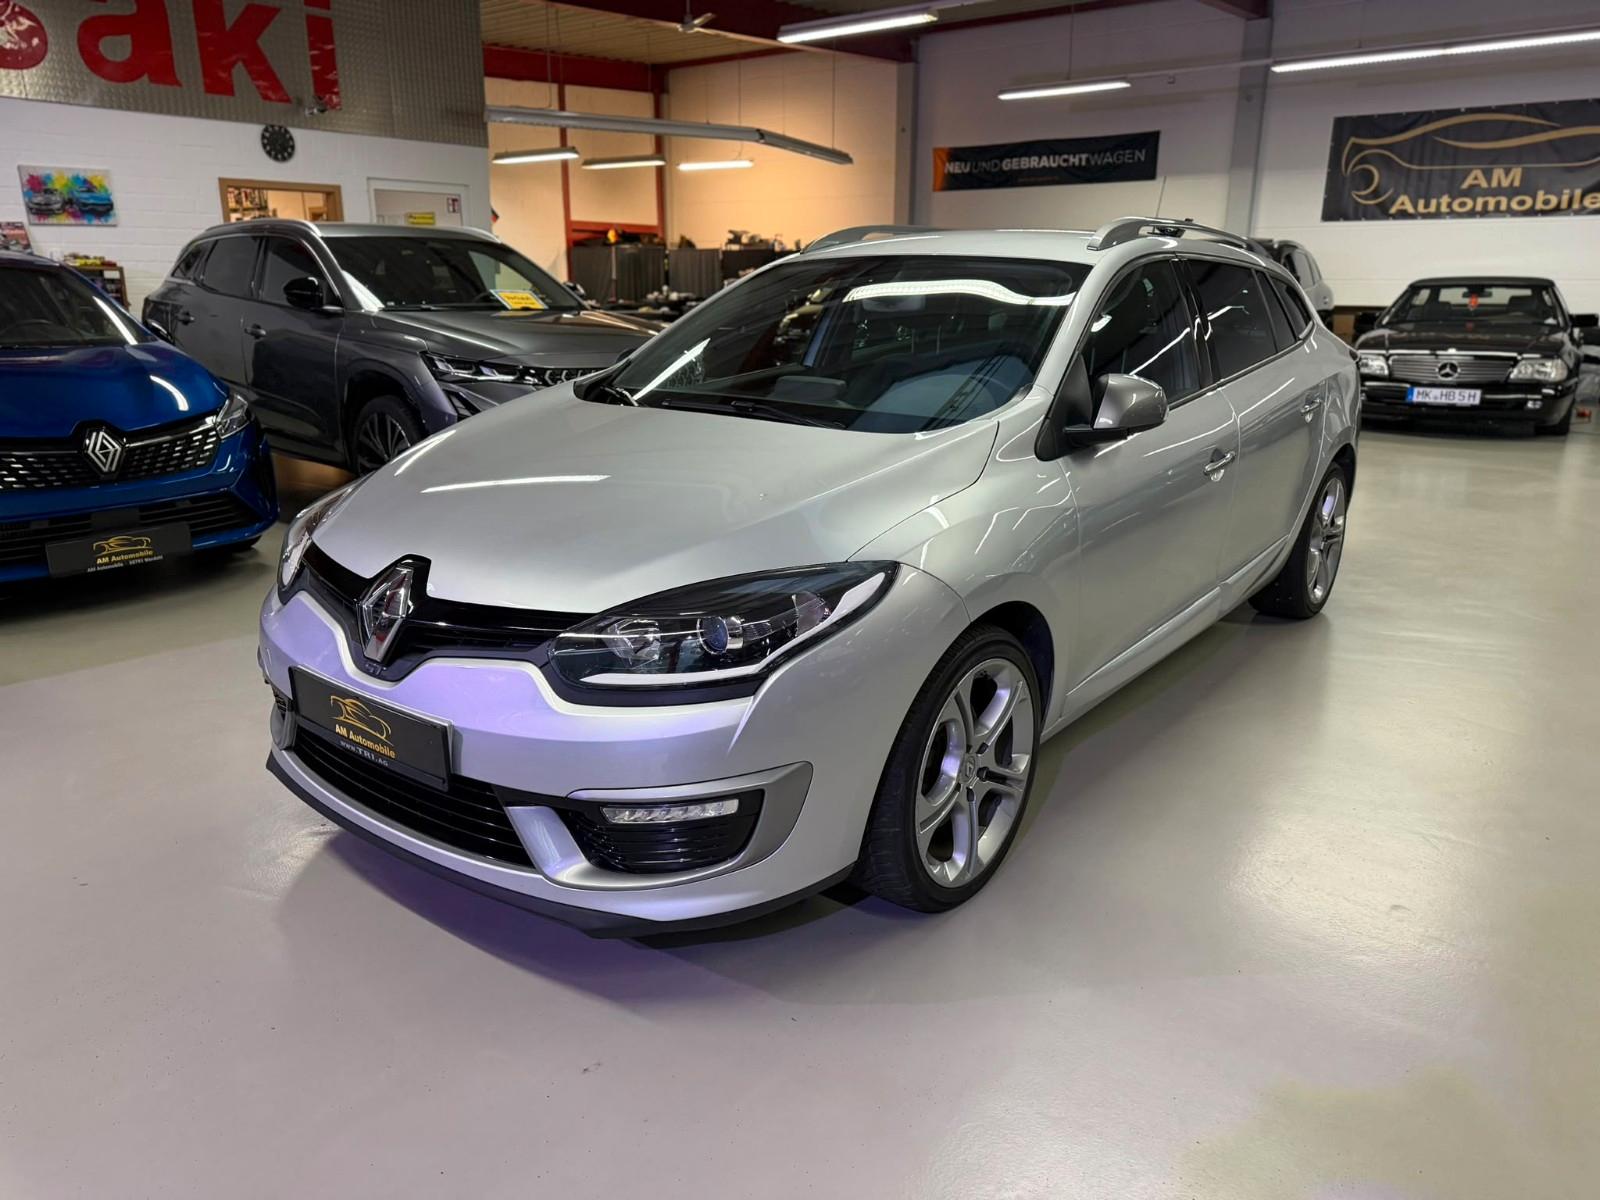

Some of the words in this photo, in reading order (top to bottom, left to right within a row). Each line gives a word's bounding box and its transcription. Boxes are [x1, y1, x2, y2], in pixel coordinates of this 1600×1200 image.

[1461, 168, 1522, 190] AM
[1416, 389, 1432, 401] MK
[96, 557, 109, 565] AM
[111, 549, 153, 562] Automobile
[335, 724, 348, 738] AM
[350, 730, 396, 759] Automobile
